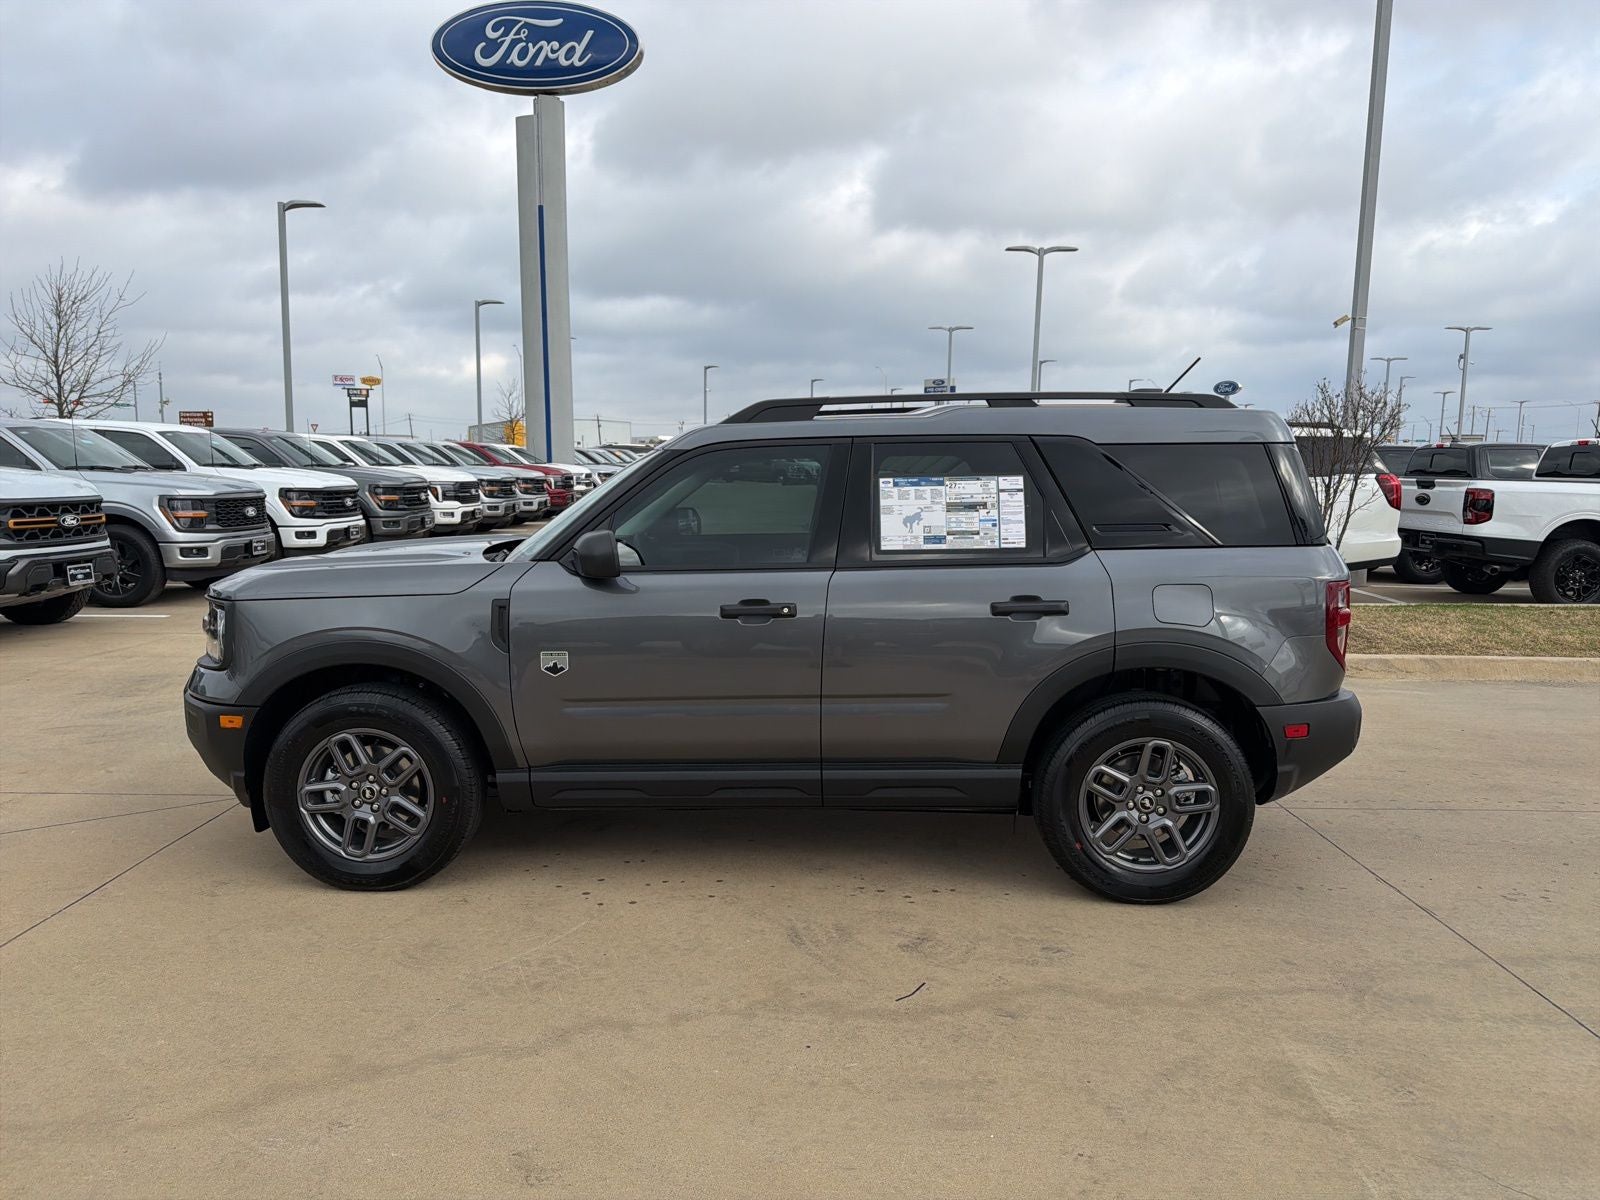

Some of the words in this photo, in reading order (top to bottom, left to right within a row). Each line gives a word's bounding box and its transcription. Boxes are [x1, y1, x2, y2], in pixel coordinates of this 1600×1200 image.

[474, 15, 595, 67] Ford
[334, 375, 354, 384] Exxon
[1217, 383, 1234, 393] Ford
[64, 515, 78, 525] Ford
